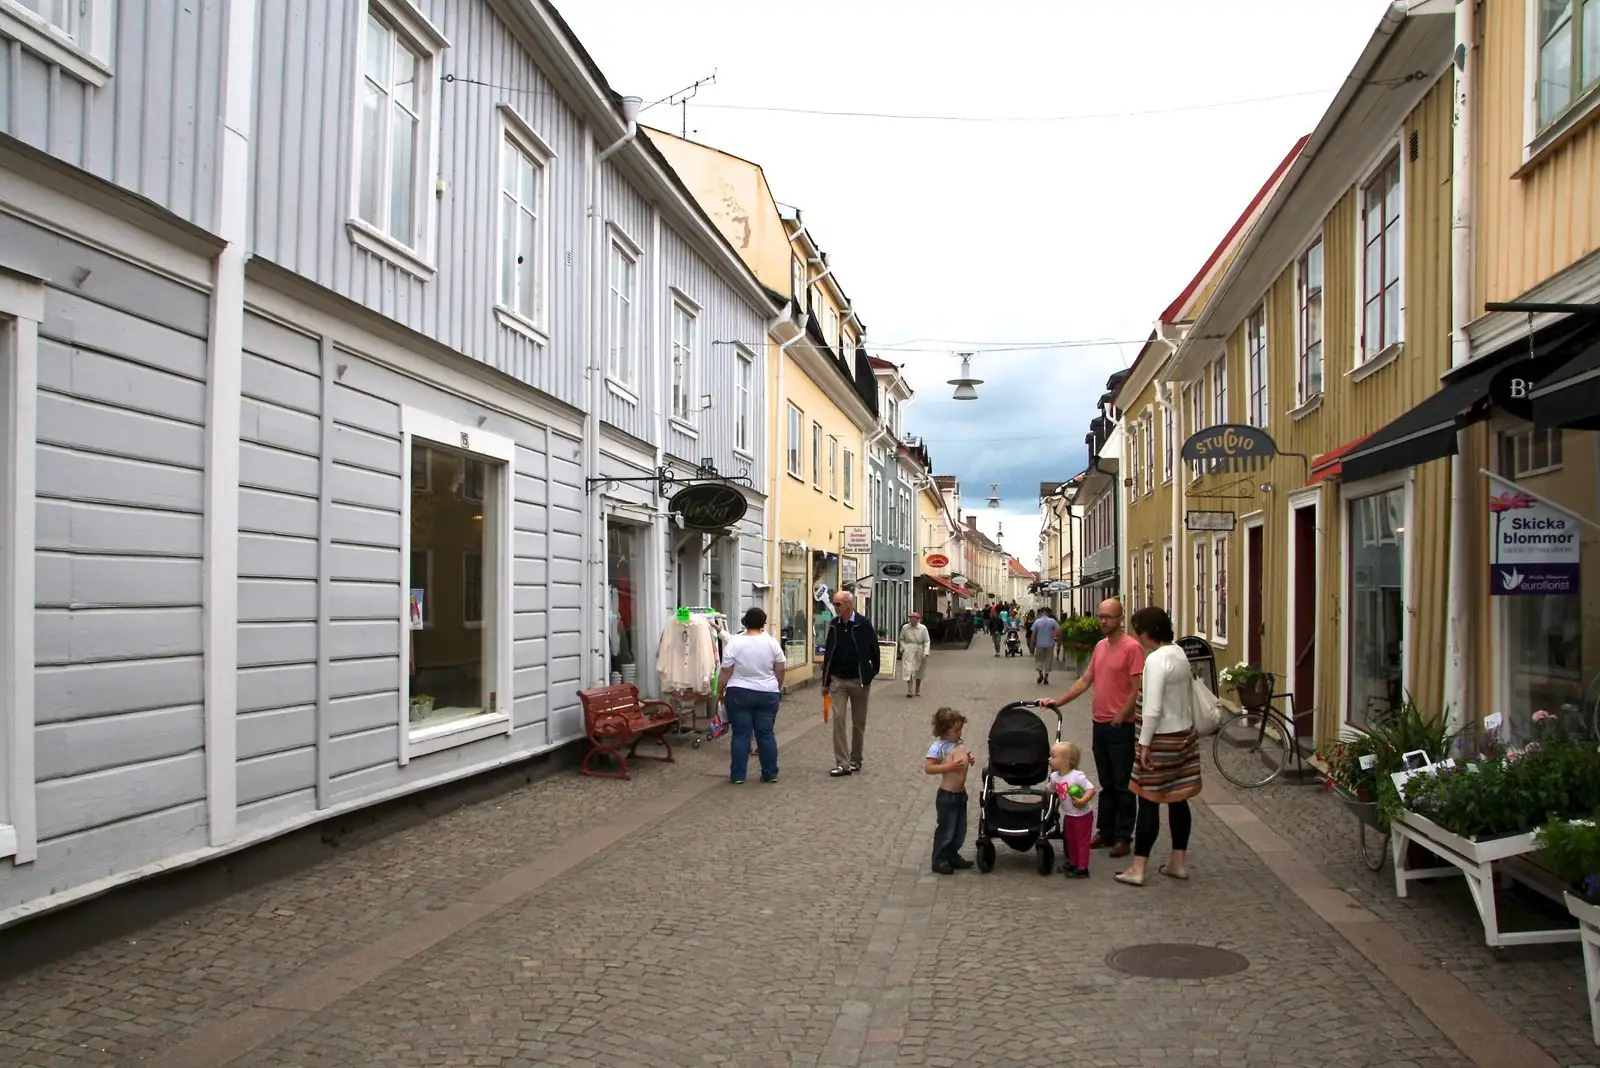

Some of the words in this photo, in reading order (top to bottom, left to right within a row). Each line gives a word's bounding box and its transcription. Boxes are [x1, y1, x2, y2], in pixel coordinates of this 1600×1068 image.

[1511, 517, 1565, 530] Skicka
[1503, 532, 1574, 544] blommor
[1521, 580, 1569, 590] euroflorist
